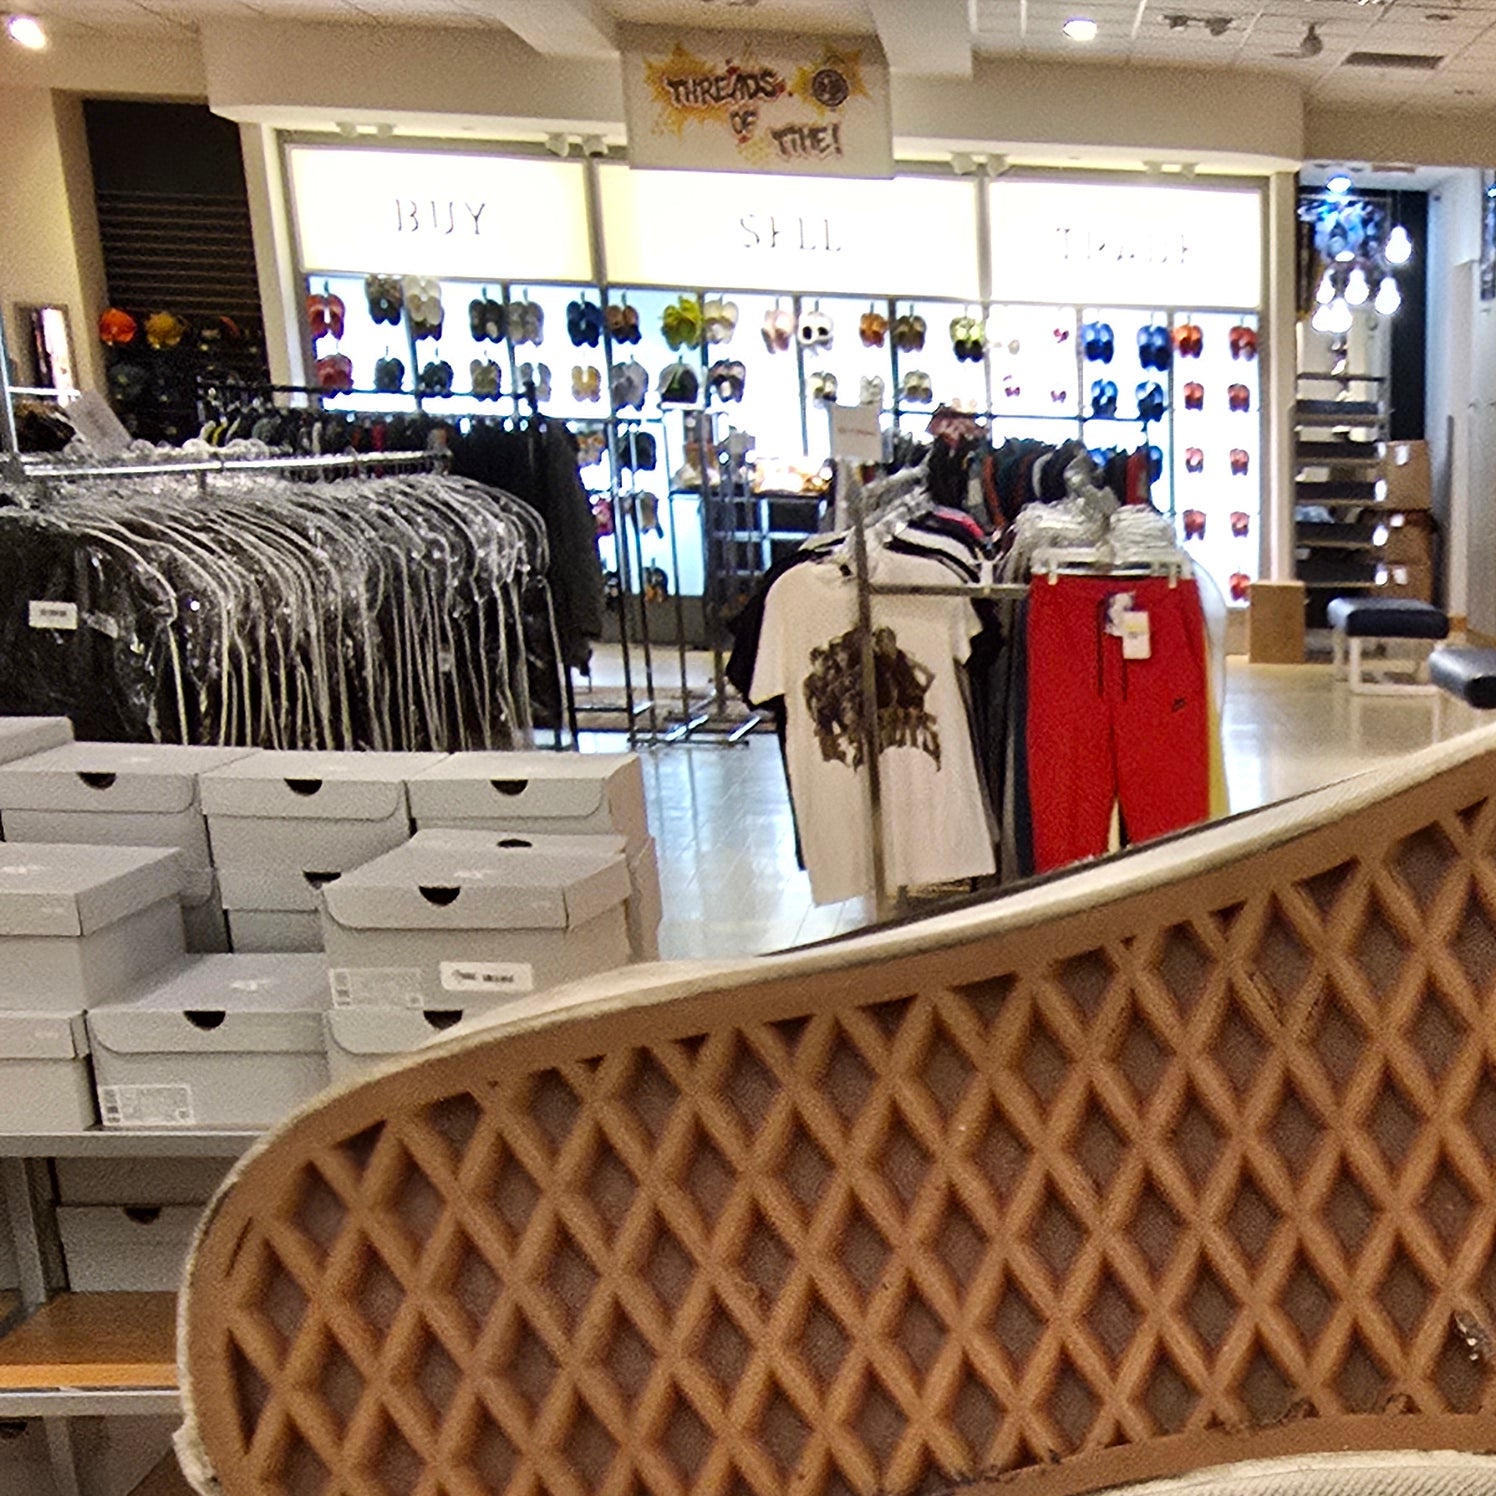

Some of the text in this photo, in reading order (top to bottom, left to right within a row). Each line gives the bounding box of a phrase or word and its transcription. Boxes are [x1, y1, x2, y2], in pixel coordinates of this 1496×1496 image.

[666, 68, 778, 106] THREADS
[729, 110, 757, 135] OF
[395, 199, 486, 235] BUY
